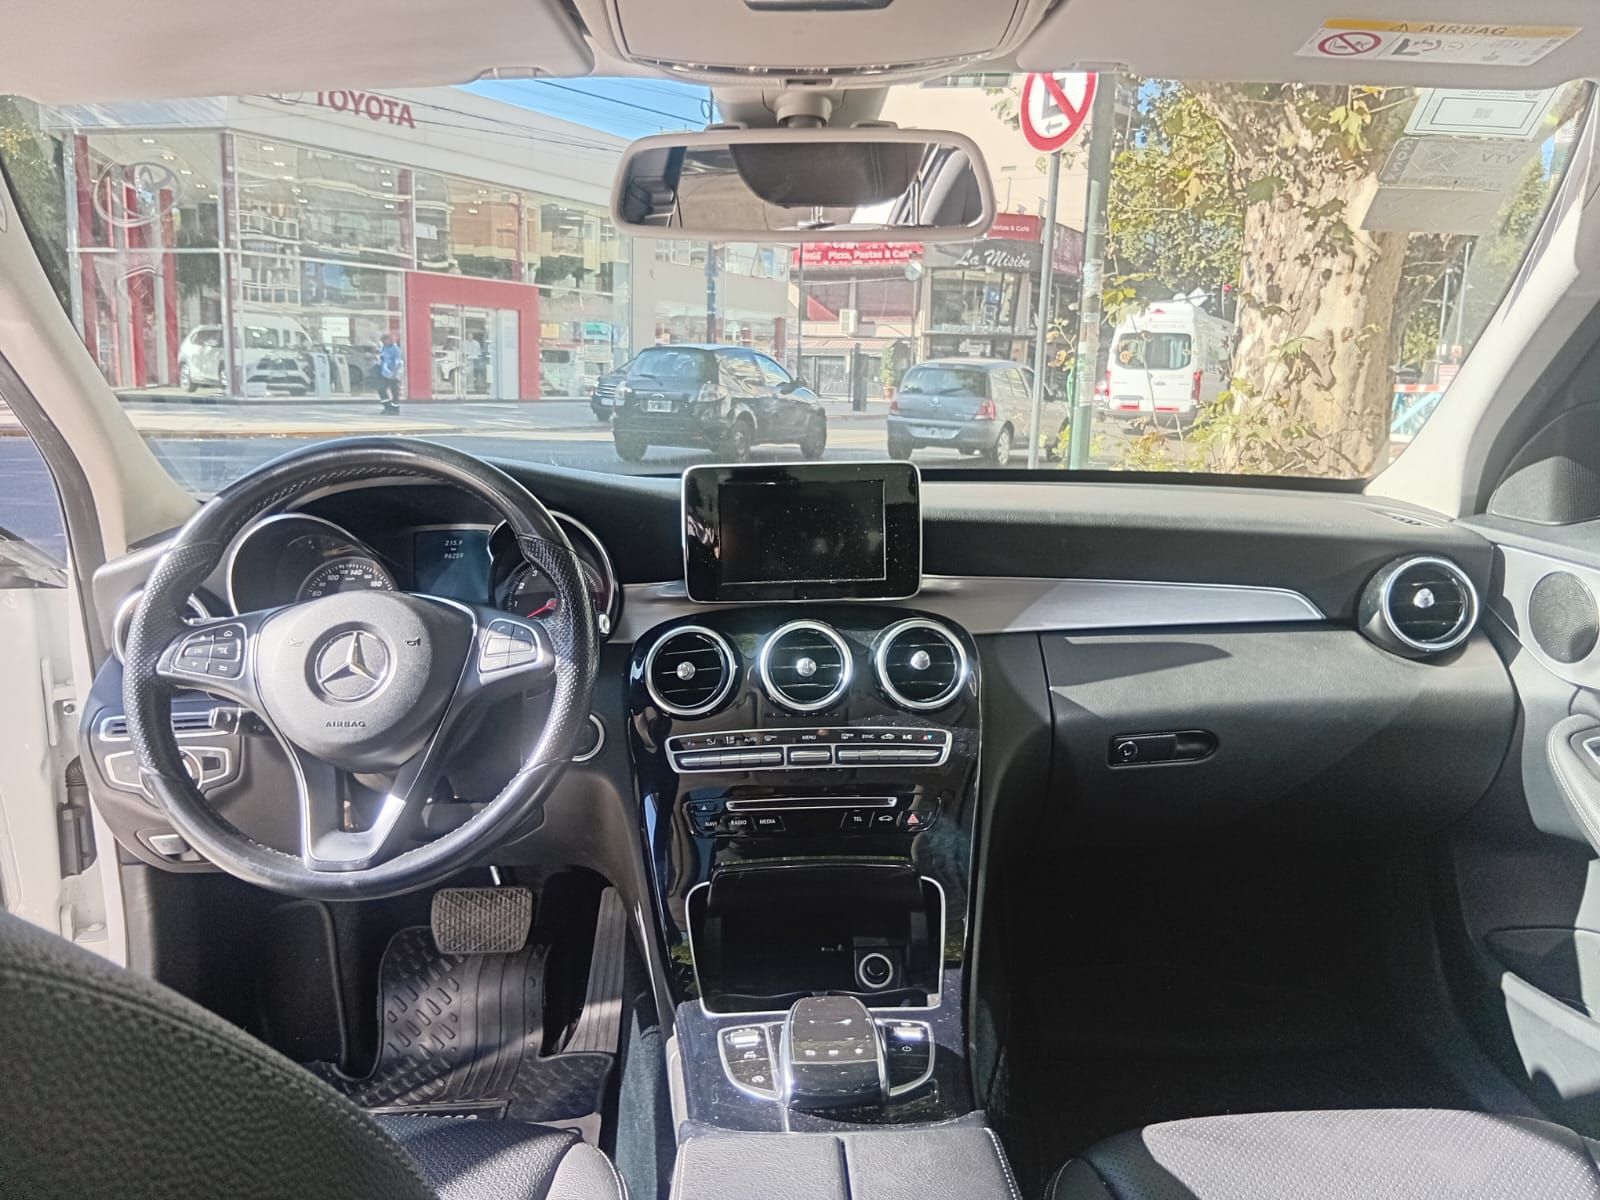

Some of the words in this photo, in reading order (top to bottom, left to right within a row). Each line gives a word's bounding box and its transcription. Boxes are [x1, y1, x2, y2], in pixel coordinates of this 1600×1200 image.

[1423, 25, 1508, 36] AIRBAG
[955, 249, 980, 266] La
[984, 248, 1031, 268] Misión
[325, 720, 367, 728] AIRBAG
